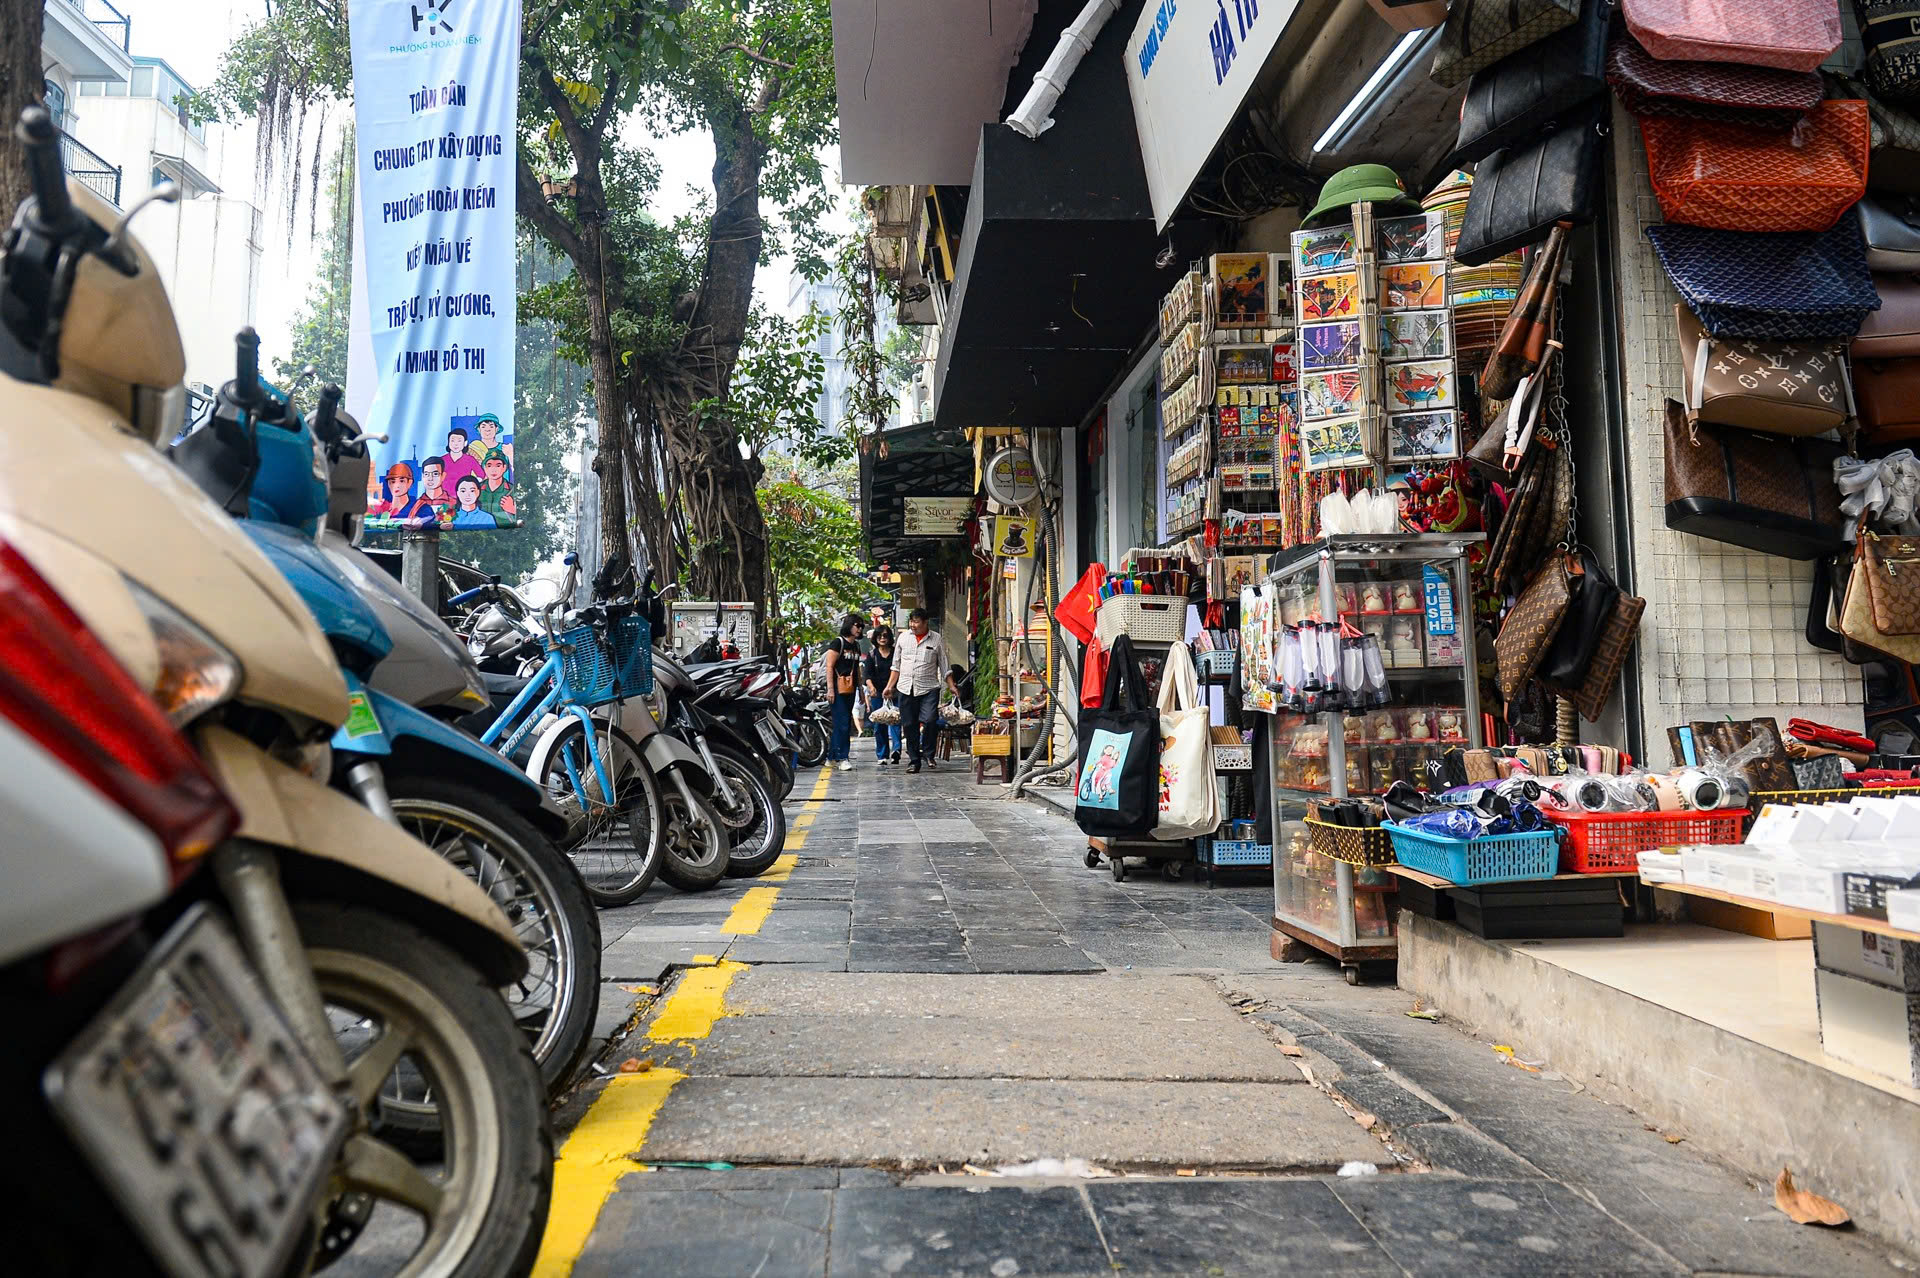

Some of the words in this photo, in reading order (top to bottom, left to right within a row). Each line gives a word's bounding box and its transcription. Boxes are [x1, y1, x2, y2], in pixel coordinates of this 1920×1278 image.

[409, 85, 437, 114] TOÀN
[440, 79, 467, 107] DÂN
[373, 146, 415, 171] CHUNG
[417, 138, 435, 162] TAY
[438, 132, 464, 160] XÂY
[466, 134, 502, 162] DỰNG
[383, 193, 424, 223] PHƯỜNG
[426, 185, 459, 212] HOÀN
[463, 182, 496, 210] KIẾM
[424, 237, 451, 266] MẪU
[456, 236, 473, 264] VỀ
[387, 299, 409, 330] TRẬ
[445, 292, 496, 319] CƯƠNG,
[405, 349, 439, 374] MINH
[443, 343, 460, 371] ĐÔ
[464, 347, 486, 375] THỊ
[1425, 582, 1441, 632] PUSH
